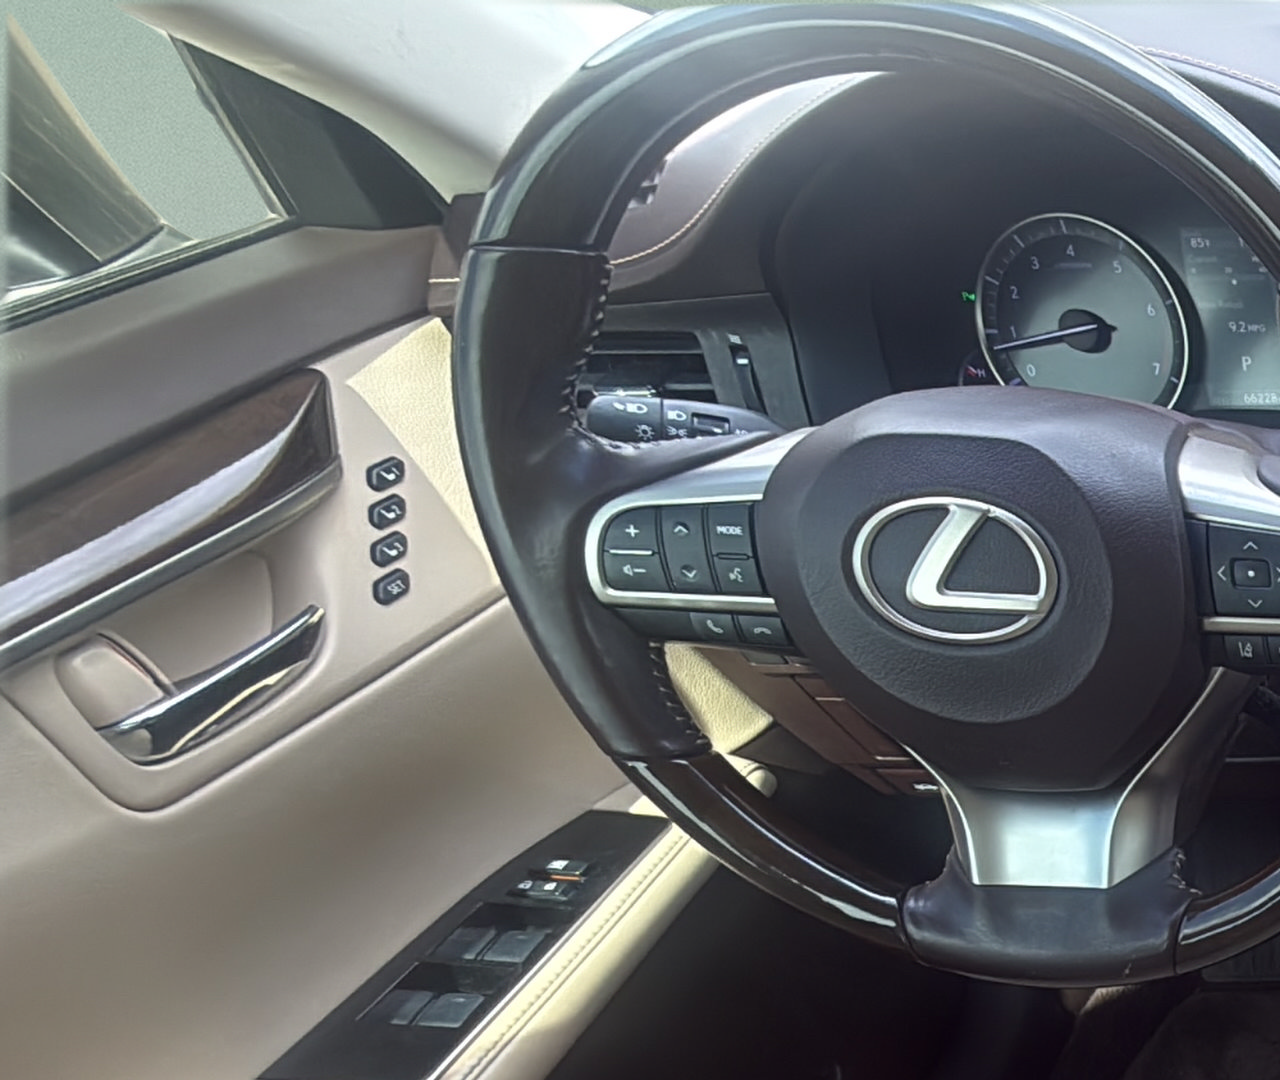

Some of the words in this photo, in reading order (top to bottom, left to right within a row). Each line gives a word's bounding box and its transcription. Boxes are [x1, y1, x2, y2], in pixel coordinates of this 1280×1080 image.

[1066, 244, 1075, 256] 4
[1030, 256, 1040, 270] 3
[1112, 260, 1122, 274] 5
[1010, 286, 1020, 299] 2
[1147, 304, 1156, 316] 6
[1010, 326, 1016, 339] 1
[1228, 322, 1247, 332] 9.2
[1026, 364, 1036, 376] 0
[1152, 362, 1160, 376] 7
[1242, 356, 1252, 372] P
[716, 525, 744, 536] MODE
